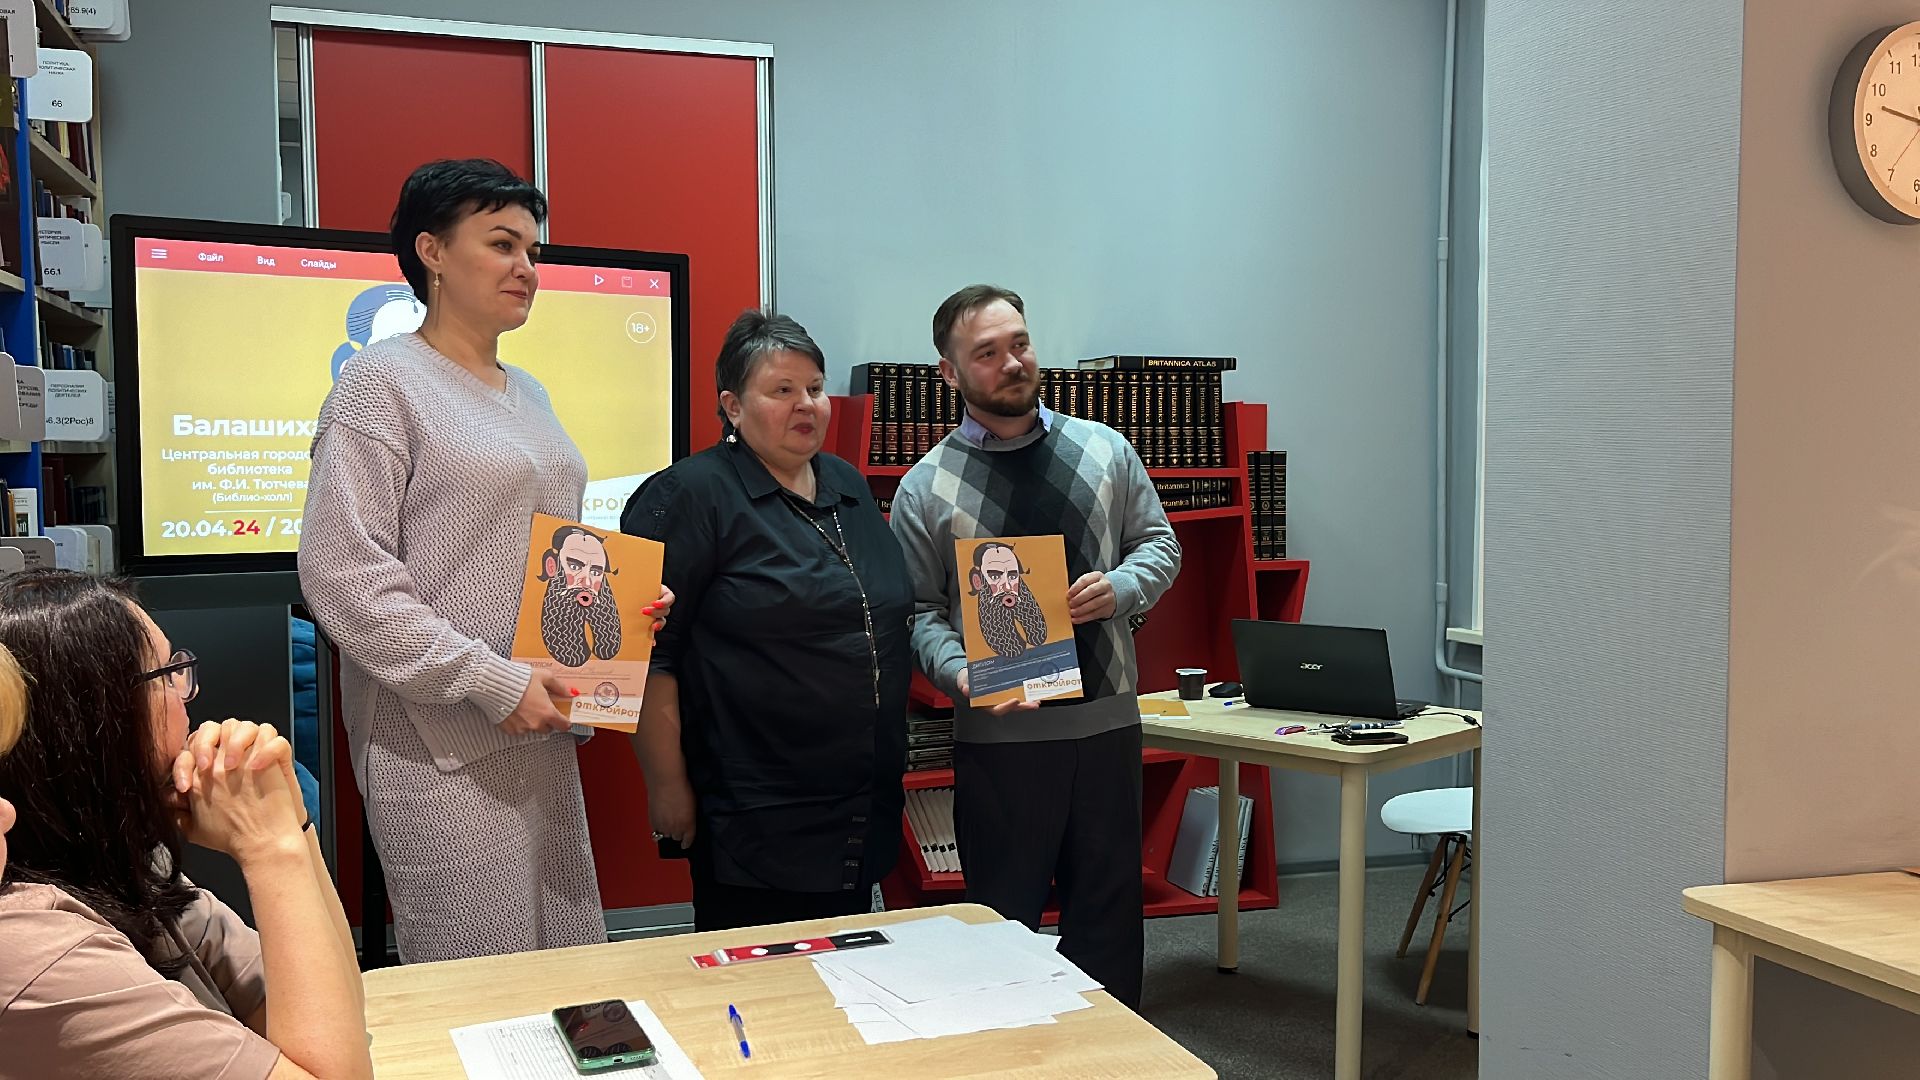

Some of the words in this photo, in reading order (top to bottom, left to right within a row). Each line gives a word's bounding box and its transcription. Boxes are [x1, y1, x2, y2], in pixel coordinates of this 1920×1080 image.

[1911, 54, 1920, 68] 1
[1889, 61, 1901, 75] 11
[1872, 83, 1886, 97] 10
[1865, 113, 1873, 126] 9
[1870, 144, 1877, 157] 8
[1888, 168, 1895, 182] 7
[198, 252, 224, 262] Файл
[257, 256, 276, 266] Вид
[301, 259, 337, 269] Слайды
[631, 322, 650, 333] 18+
[1148, 359, 1191, 367] BRITANNICA
[889, 380, 897, 418] Britannica
[173, 414, 317, 437] Балаших
[161, 449, 259, 462] Центральная
[207, 463, 293, 475] библиотека
[192, 480, 216, 490] им.
[219, 478, 249, 490] Ф.И.
[1156, 482, 1190, 490] Britannica
[212, 491, 293, 503] (Библио-холл)
[161, 519, 261, 538] 20.04.24
[1300, 662, 1324, 670] acer
